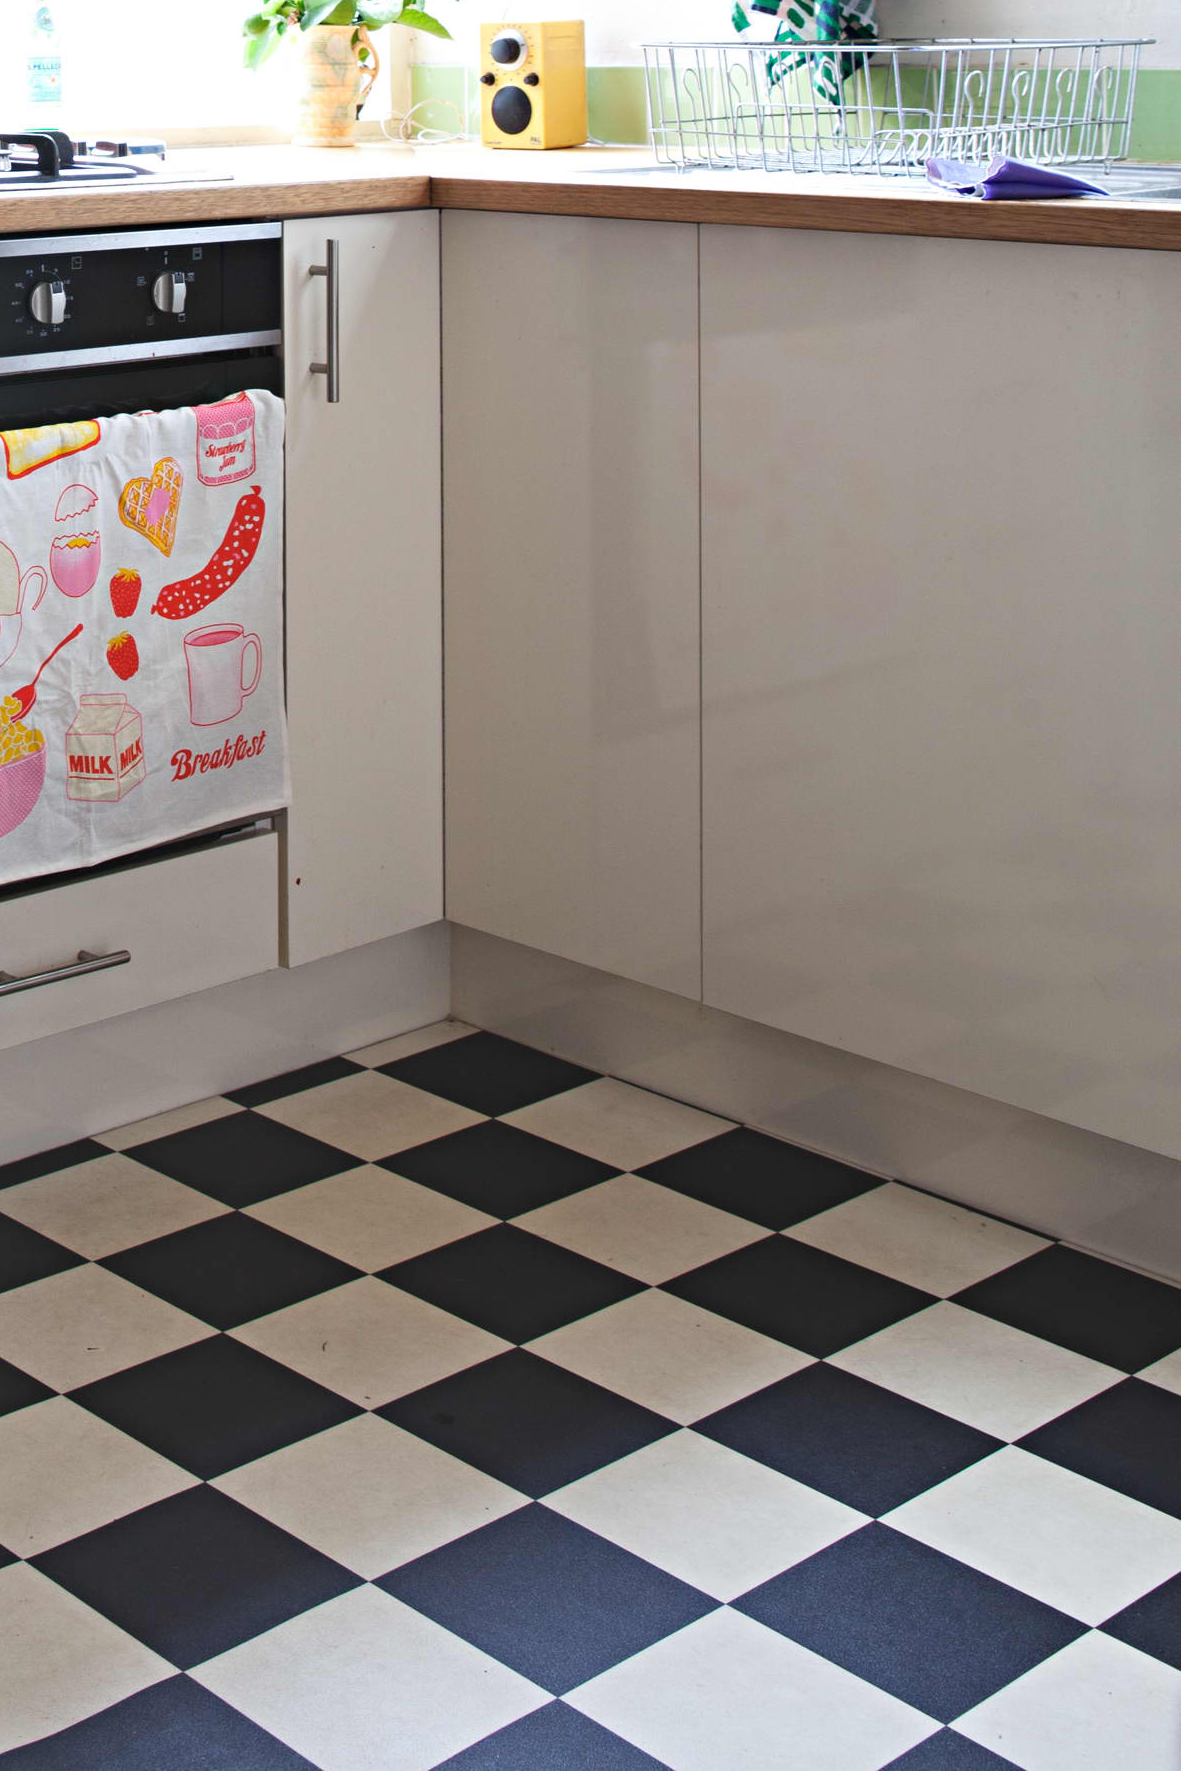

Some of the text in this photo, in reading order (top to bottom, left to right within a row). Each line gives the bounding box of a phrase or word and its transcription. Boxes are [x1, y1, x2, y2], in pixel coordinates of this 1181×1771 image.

[205, 439, 246, 458] Strawberry
[219, 456, 236, 472] Jam
[120, 735, 142, 771] MILK
[170, 730, 268, 782] Breakfast
[69, 755, 114, 774] MILK
